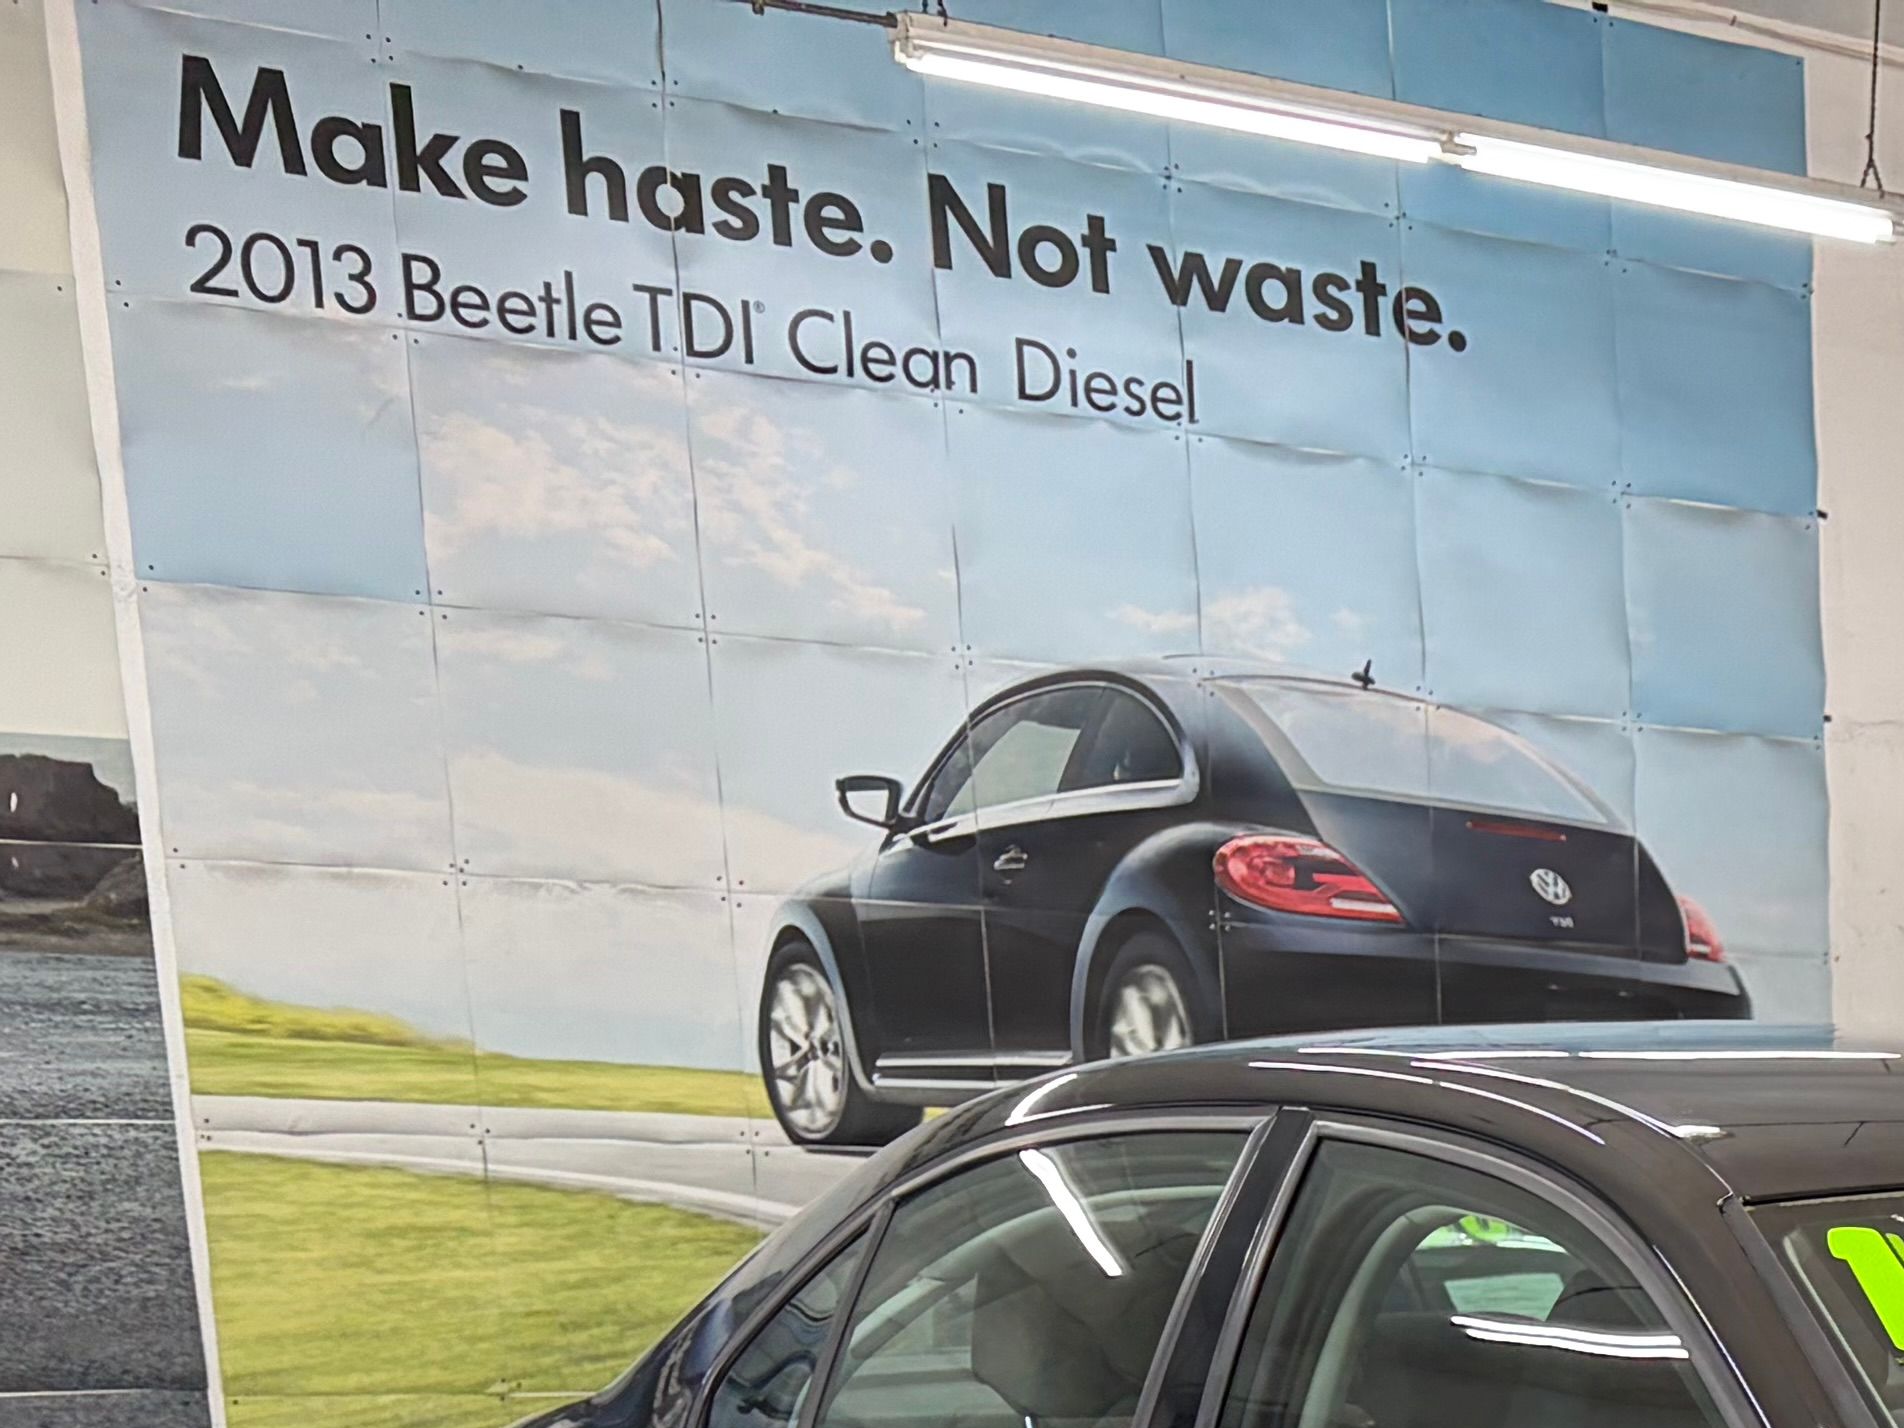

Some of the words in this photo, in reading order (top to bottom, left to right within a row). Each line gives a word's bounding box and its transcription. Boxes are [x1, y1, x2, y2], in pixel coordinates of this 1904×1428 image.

[178, 54, 529, 207] Make
[560, 108, 894, 264] haste.
[927, 172, 1117, 296] Not
[1147, 242, 1468, 353] waste.
[184, 224, 379, 315] 2013
[402, 253, 624, 347] Beetle
[788, 307, 978, 394] Clean
[1015, 337, 1200, 425] Diesel
